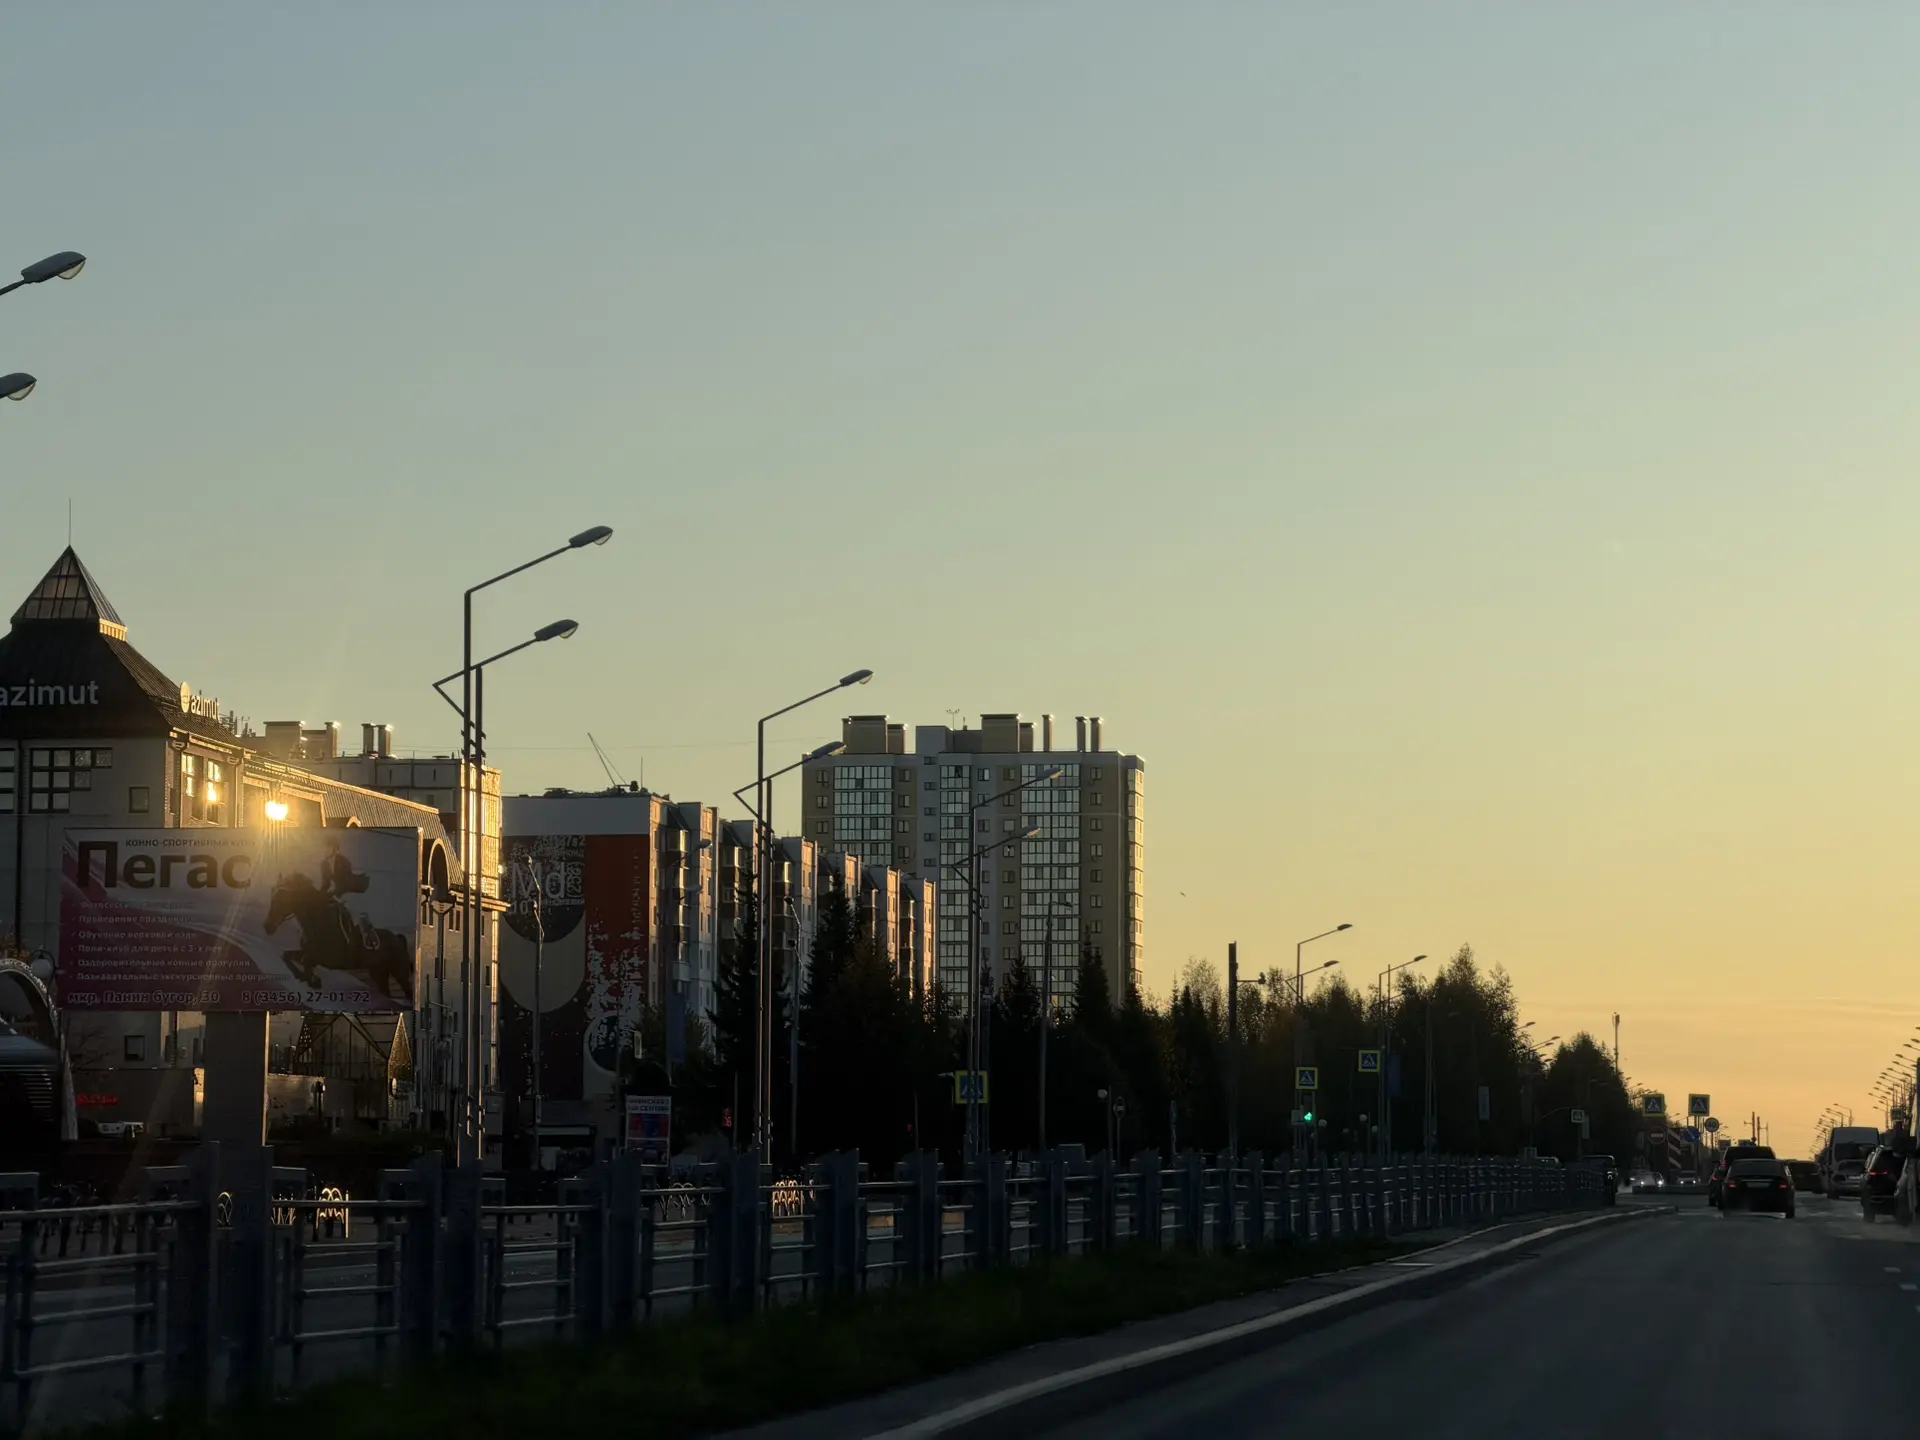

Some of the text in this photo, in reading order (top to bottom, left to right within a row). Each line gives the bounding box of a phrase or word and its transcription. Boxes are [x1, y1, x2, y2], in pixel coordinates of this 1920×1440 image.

[0, 678, 99, 706] azimut
[190, 690, 220, 722] azimut
[76, 841, 252, 889] Пегас
[151, 945, 179, 953] детей
[68, 991, 101, 1006] мкр.
[103, 991, 150, 1004] Панин
[241, 990, 371, 1005] 8 (3456) 27-01-72
